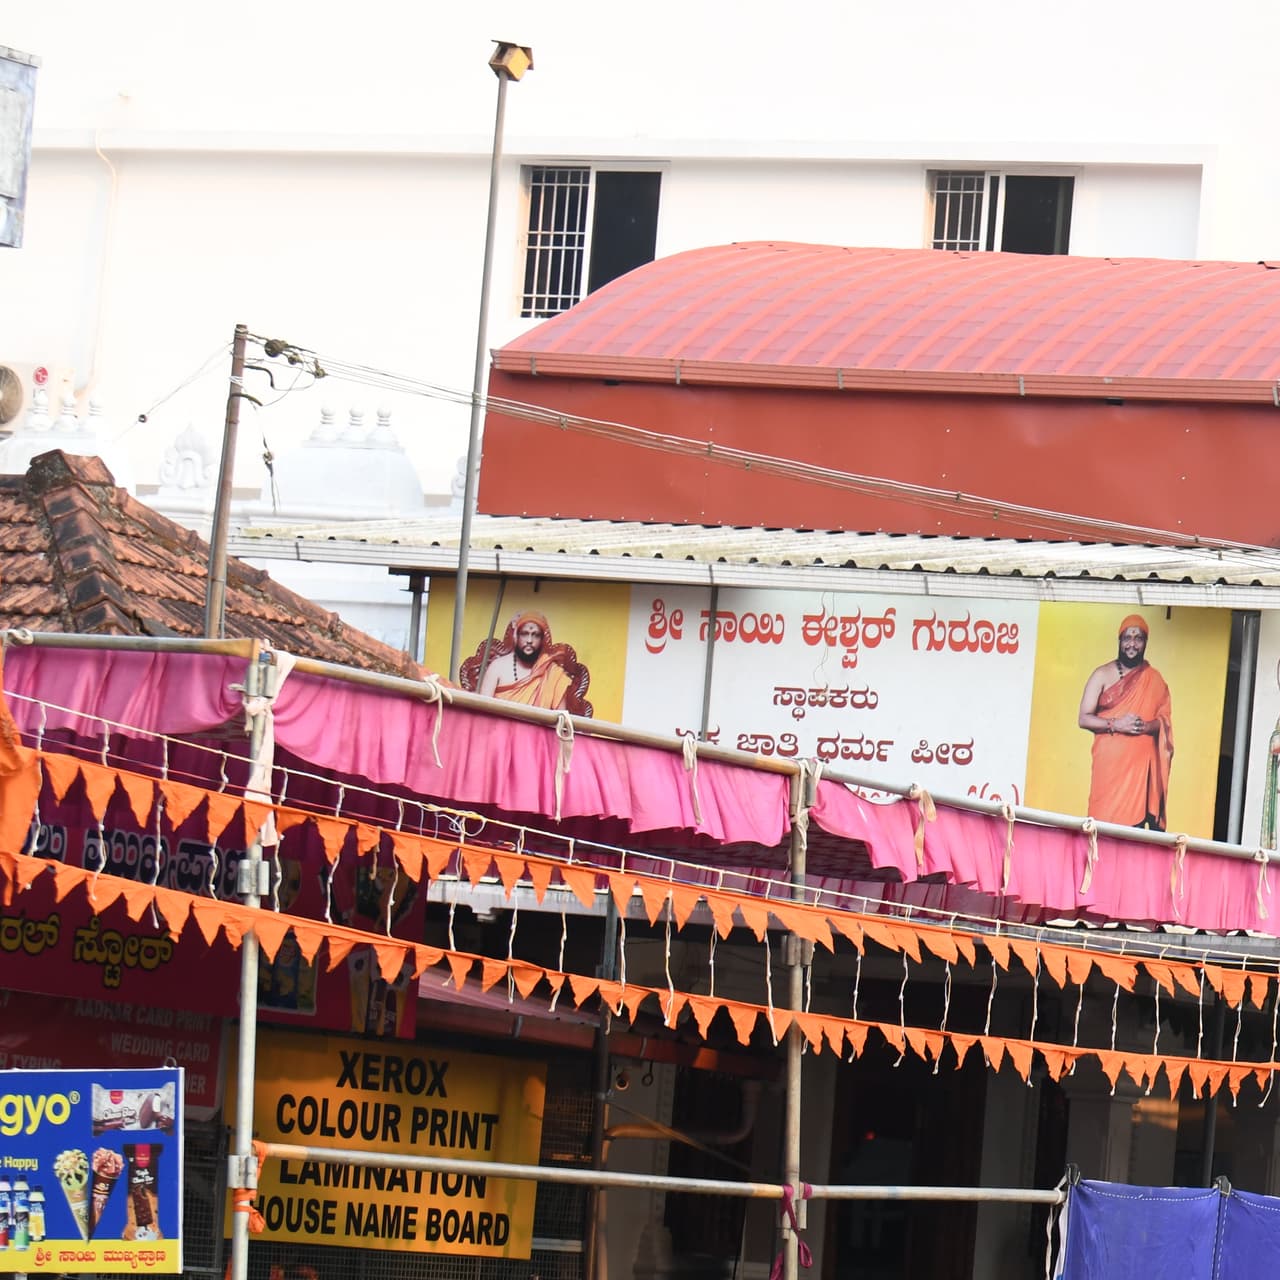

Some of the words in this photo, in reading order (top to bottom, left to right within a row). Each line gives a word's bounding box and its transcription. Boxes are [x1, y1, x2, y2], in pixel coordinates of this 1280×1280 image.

[645, 598, 683, 654] ಶ್ರೀ
[700, 606, 785, 645] ಸಾಯಿ
[801, 604, 896, 668] ಈಶ್ವರ್
[773, 683, 879, 721] ಸ್ಥಾಪಕರು
[817, 732, 894, 764] ಧರ್ಮ
[911, 737, 975, 766] ಪೀಠ
[111, 1031, 173, 1057] WEDDING
[174, 1040, 210, 1063] CARD
[336, 1050, 449, 1098] XEROX
[276, 1094, 401, 1143] COLOUR
[410, 1106, 498, 1152] PRINT
[4, 1155, 38, 1171] Happy
[254, 1194, 337, 1236] HOUSE
[345, 1201, 419, 1241] NAME
[425, 1207, 510, 1247] BOARD
[34, 1247, 52, 1267] ಶ್ರೀ
